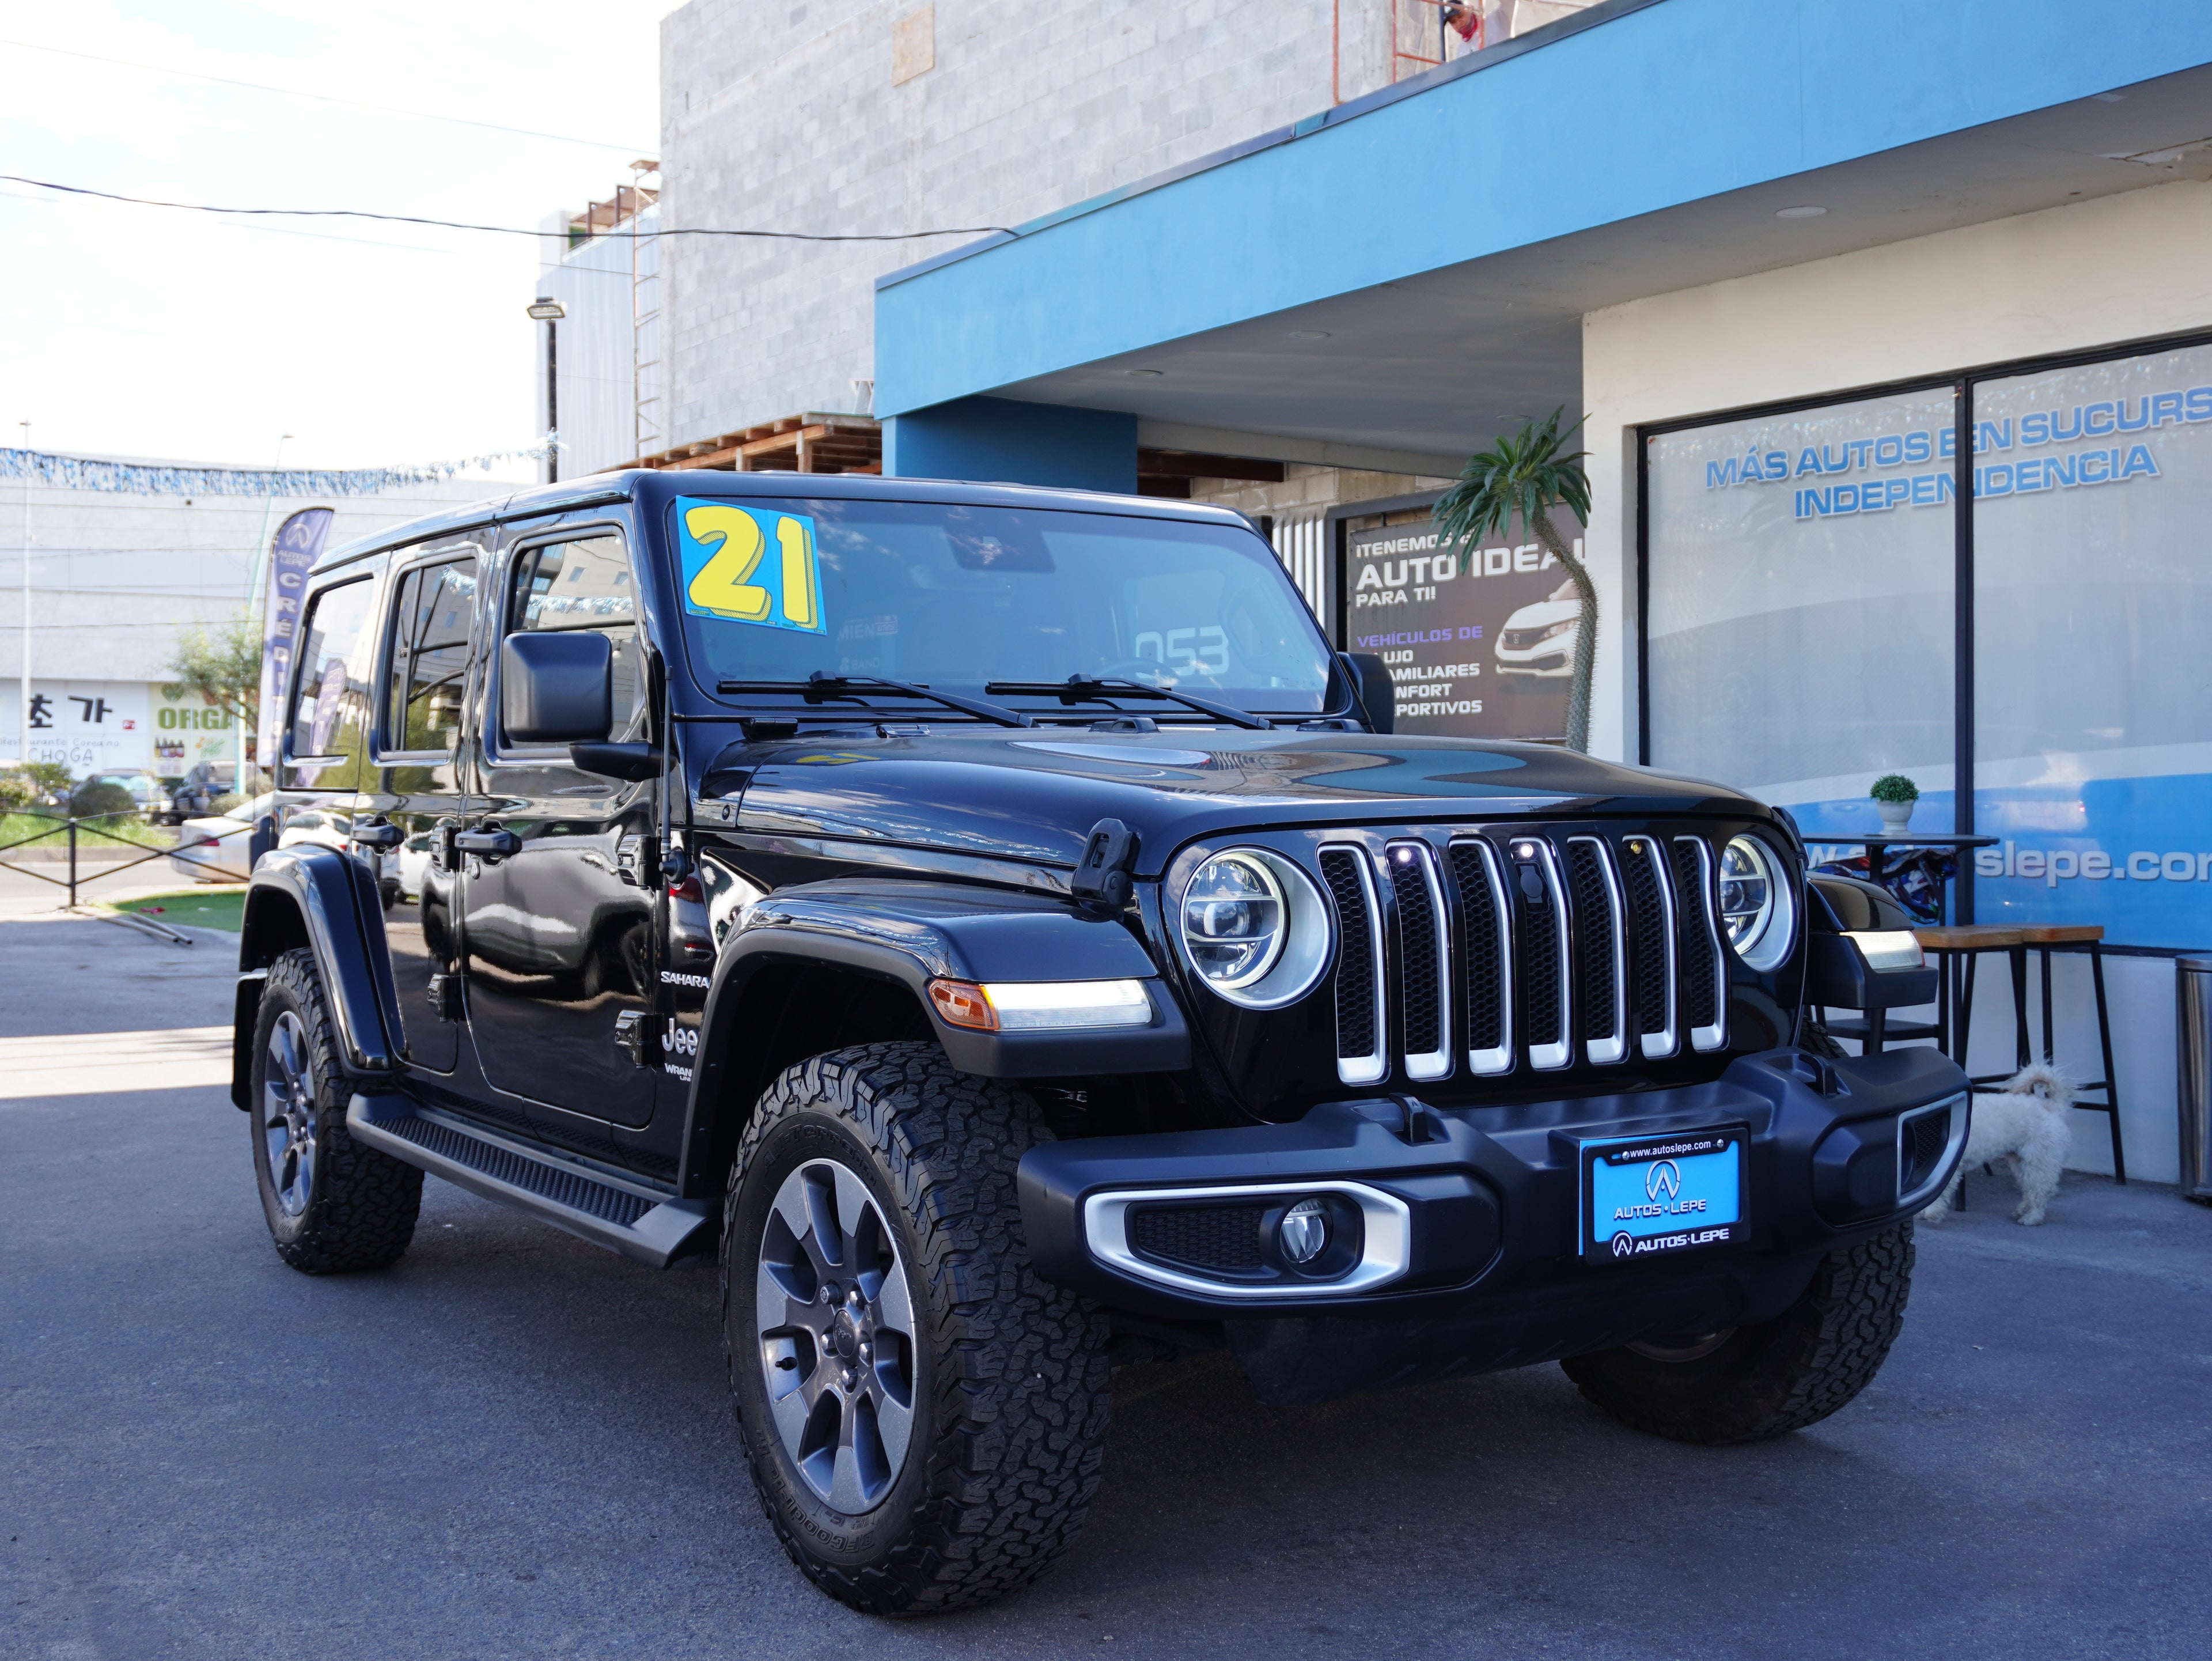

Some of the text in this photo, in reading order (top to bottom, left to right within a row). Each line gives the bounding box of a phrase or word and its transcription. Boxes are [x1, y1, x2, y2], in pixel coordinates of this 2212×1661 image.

[1706, 384, 2212, 489] MÁS AUTOS EN SUCURS
[1794, 442, 2160, 519] INDEPENDENCIA
[279, 556, 306, 567] LEPE
[684, 505, 819, 629] 21
[1356, 554, 1457, 591] AUTO
[1356, 586, 1436, 607] PARA TI!
[1357, 626, 1483, 648] VEHÍCULOS DE
[1383, 649, 1414, 663] UJO
[1389, 663, 1480, 681] MILIARES
[1395, 683, 1452, 699] NFORT
[1395, 699, 1483, 717] PORTIVOS
[157, 707, 234, 730] ORGA
[1, 737, 66, 746] Resturante
[661, 971, 710, 989] SAHARA
[662, 1017, 699, 1056] Jee
[664, 1062, 692, 1077] WRAN
[1630, 1141, 1711, 1158] www.autoslepe.com
[1614, 1199, 1706, 1220] AUTOS LEPE
